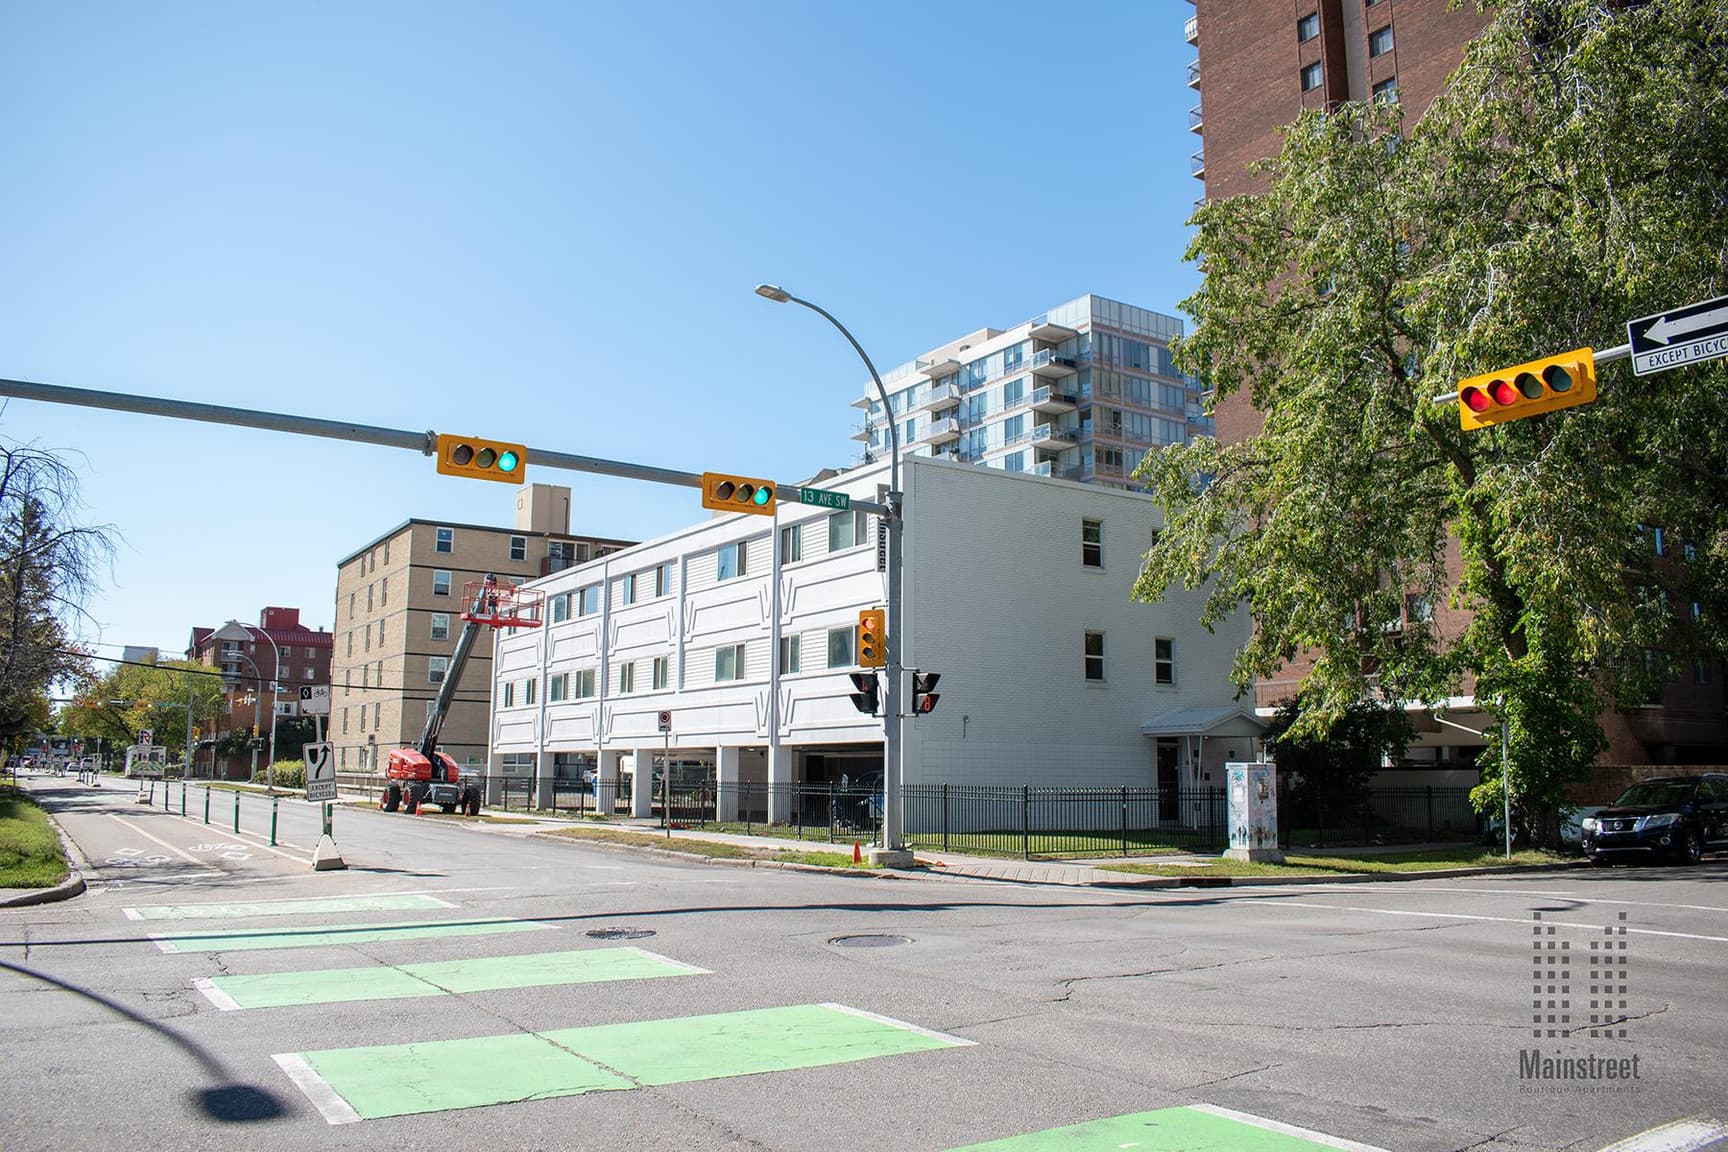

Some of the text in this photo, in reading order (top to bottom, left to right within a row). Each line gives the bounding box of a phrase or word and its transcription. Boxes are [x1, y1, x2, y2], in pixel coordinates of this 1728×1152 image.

[1649, 338, 1728, 367] EXCEPT BICYC
[803, 490, 847, 507] 13 AVE SW
